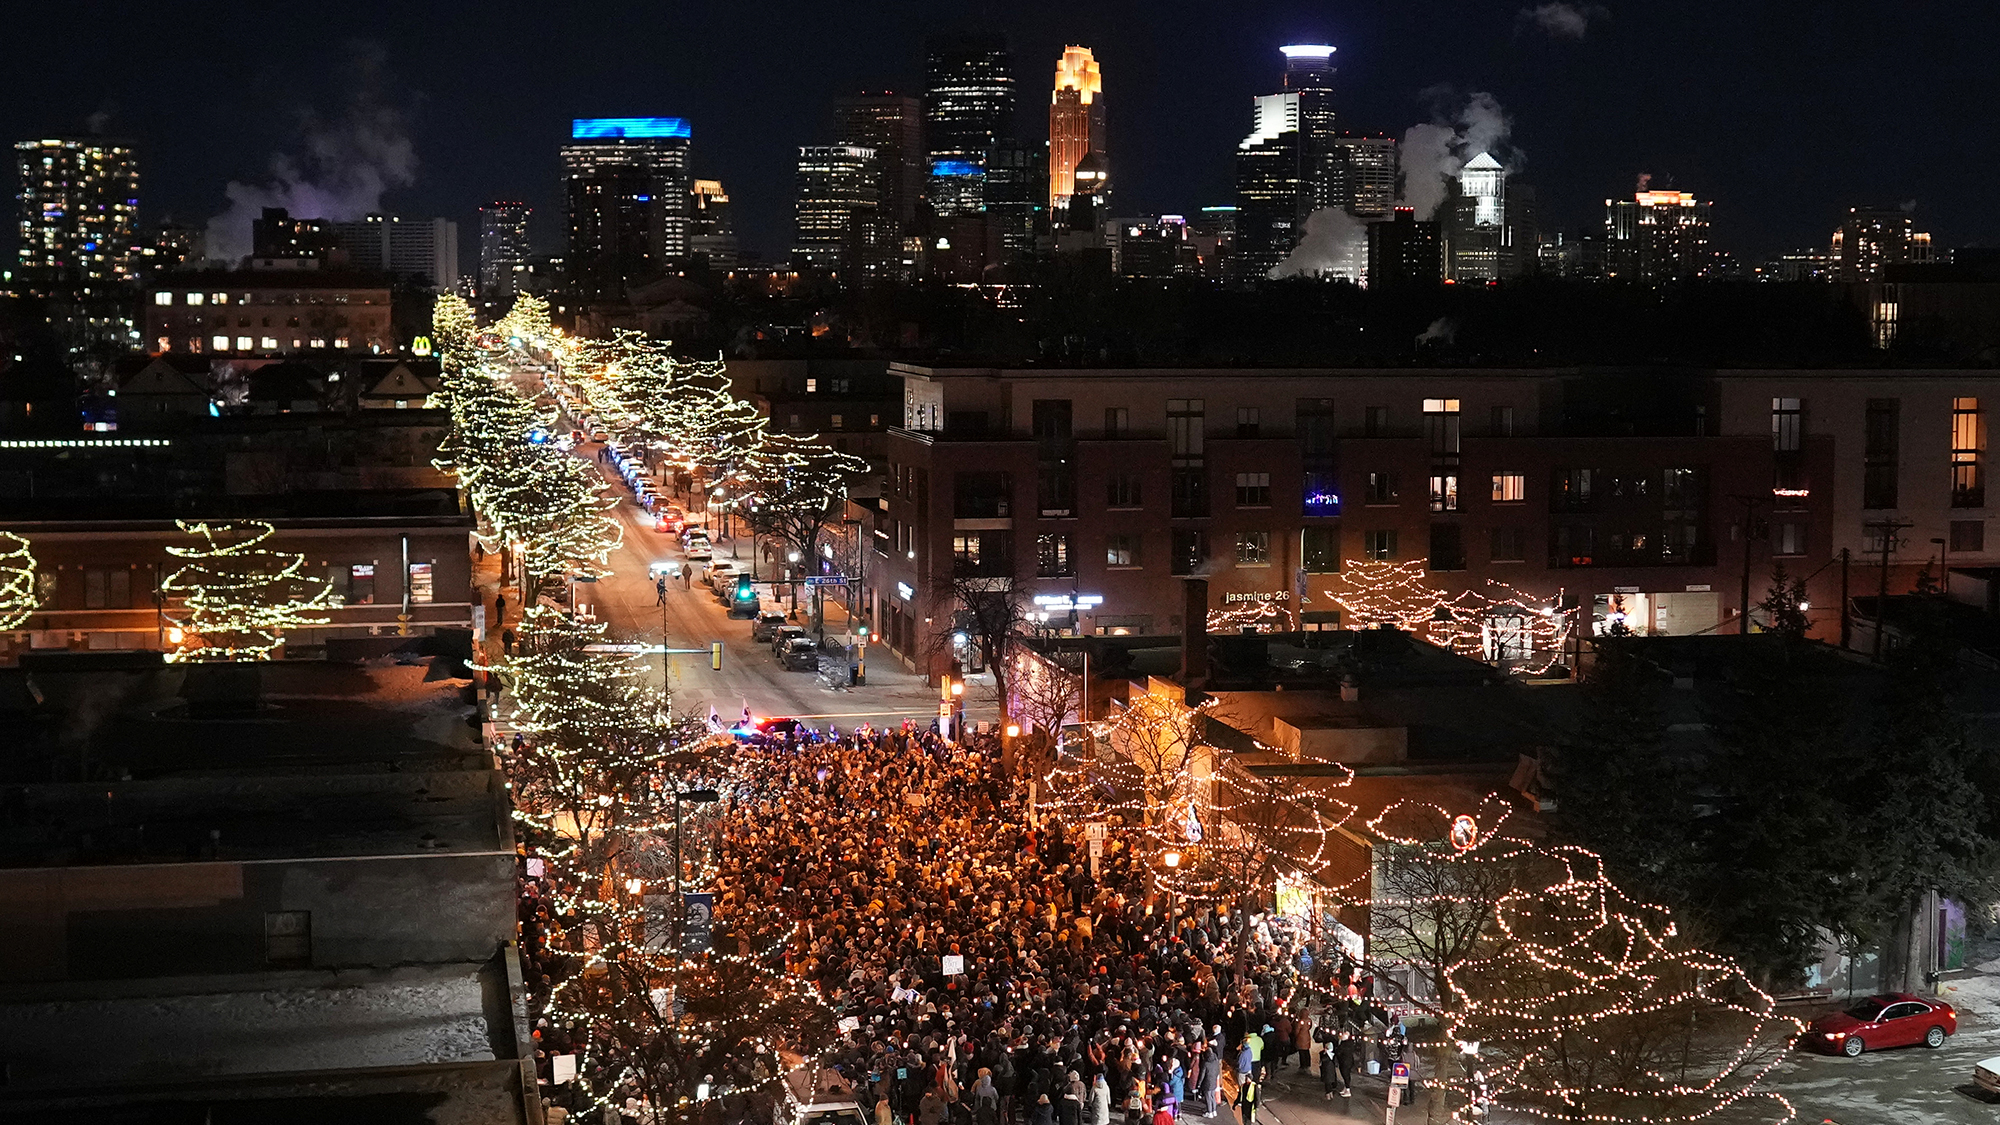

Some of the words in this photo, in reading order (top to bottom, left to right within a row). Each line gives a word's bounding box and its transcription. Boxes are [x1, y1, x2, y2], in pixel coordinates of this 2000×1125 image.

[1225, 591, 1271, 604] jasmine
[1275, 590, 1290, 601] 26
[1396, 1067, 1405, 1075] T
